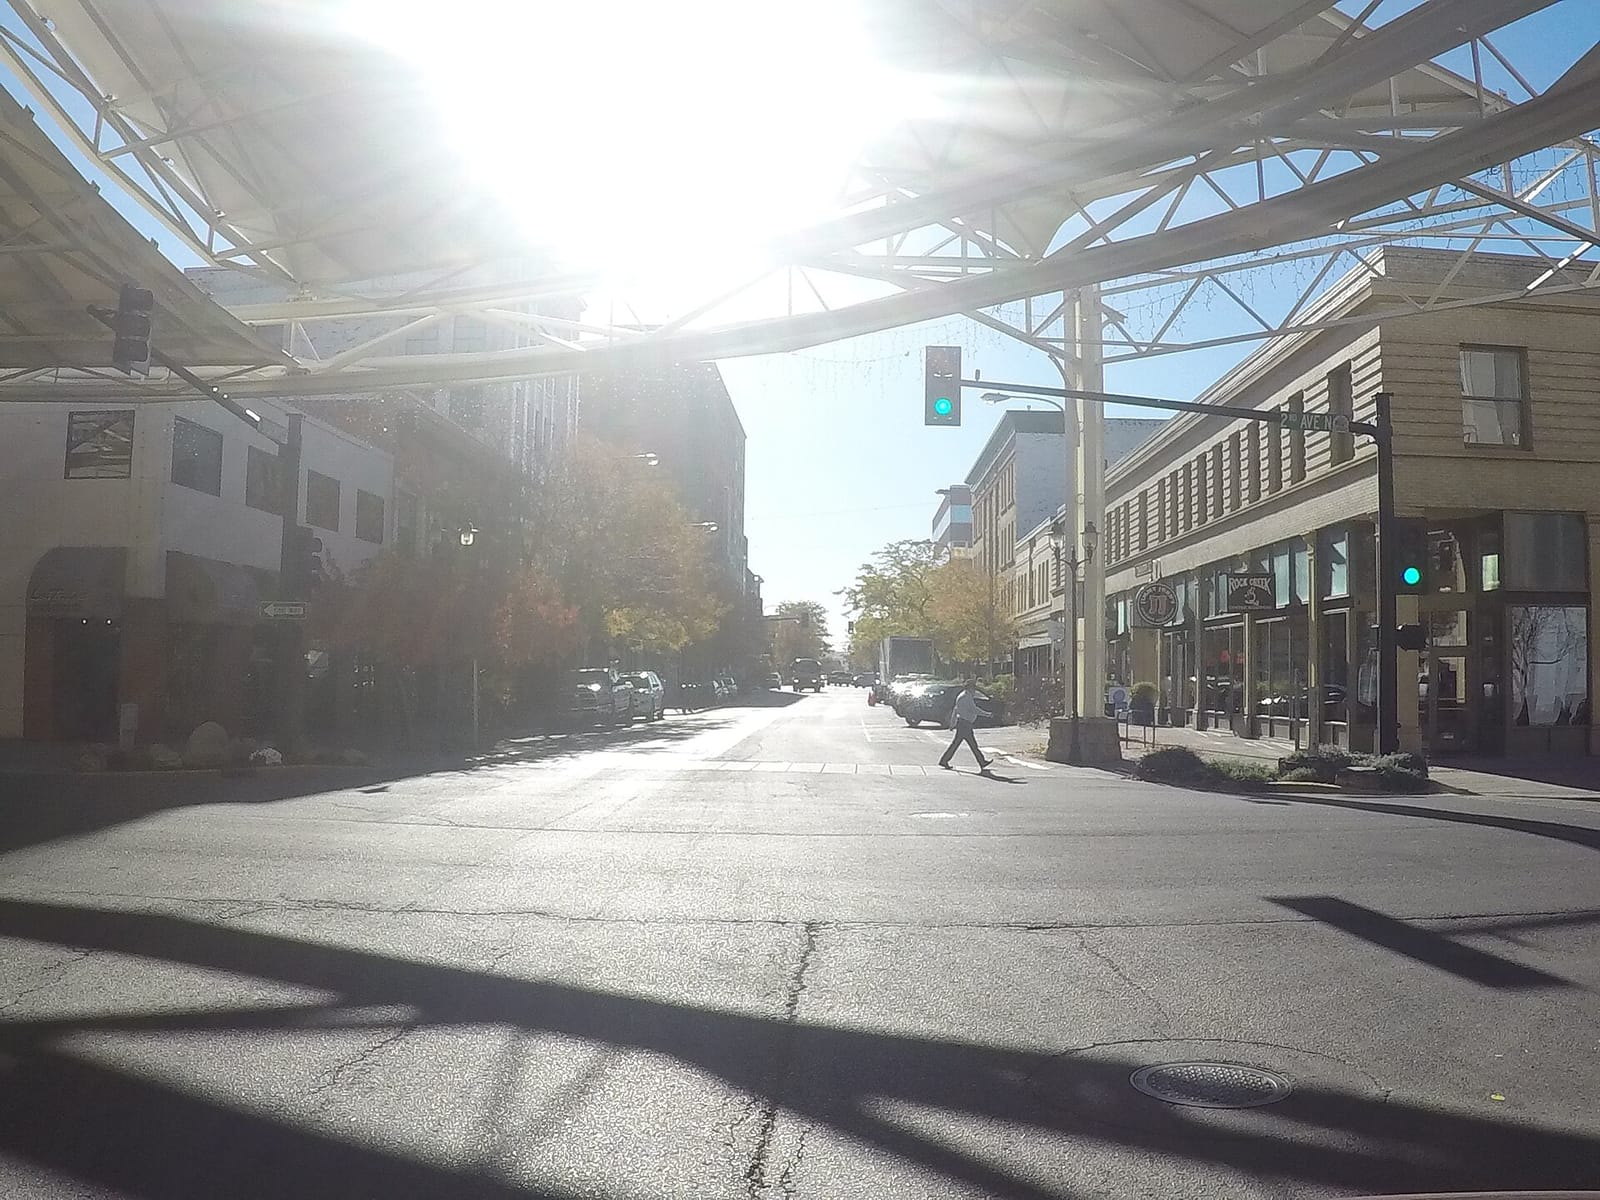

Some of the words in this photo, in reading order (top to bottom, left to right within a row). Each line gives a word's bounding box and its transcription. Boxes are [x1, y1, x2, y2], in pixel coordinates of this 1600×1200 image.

[1300, 414, 1321, 430] AVE
[1324, 415, 1333, 430] N
[1229, 577, 1248, 595] ROCK
[1249, 577, 1272, 596] CREEK
